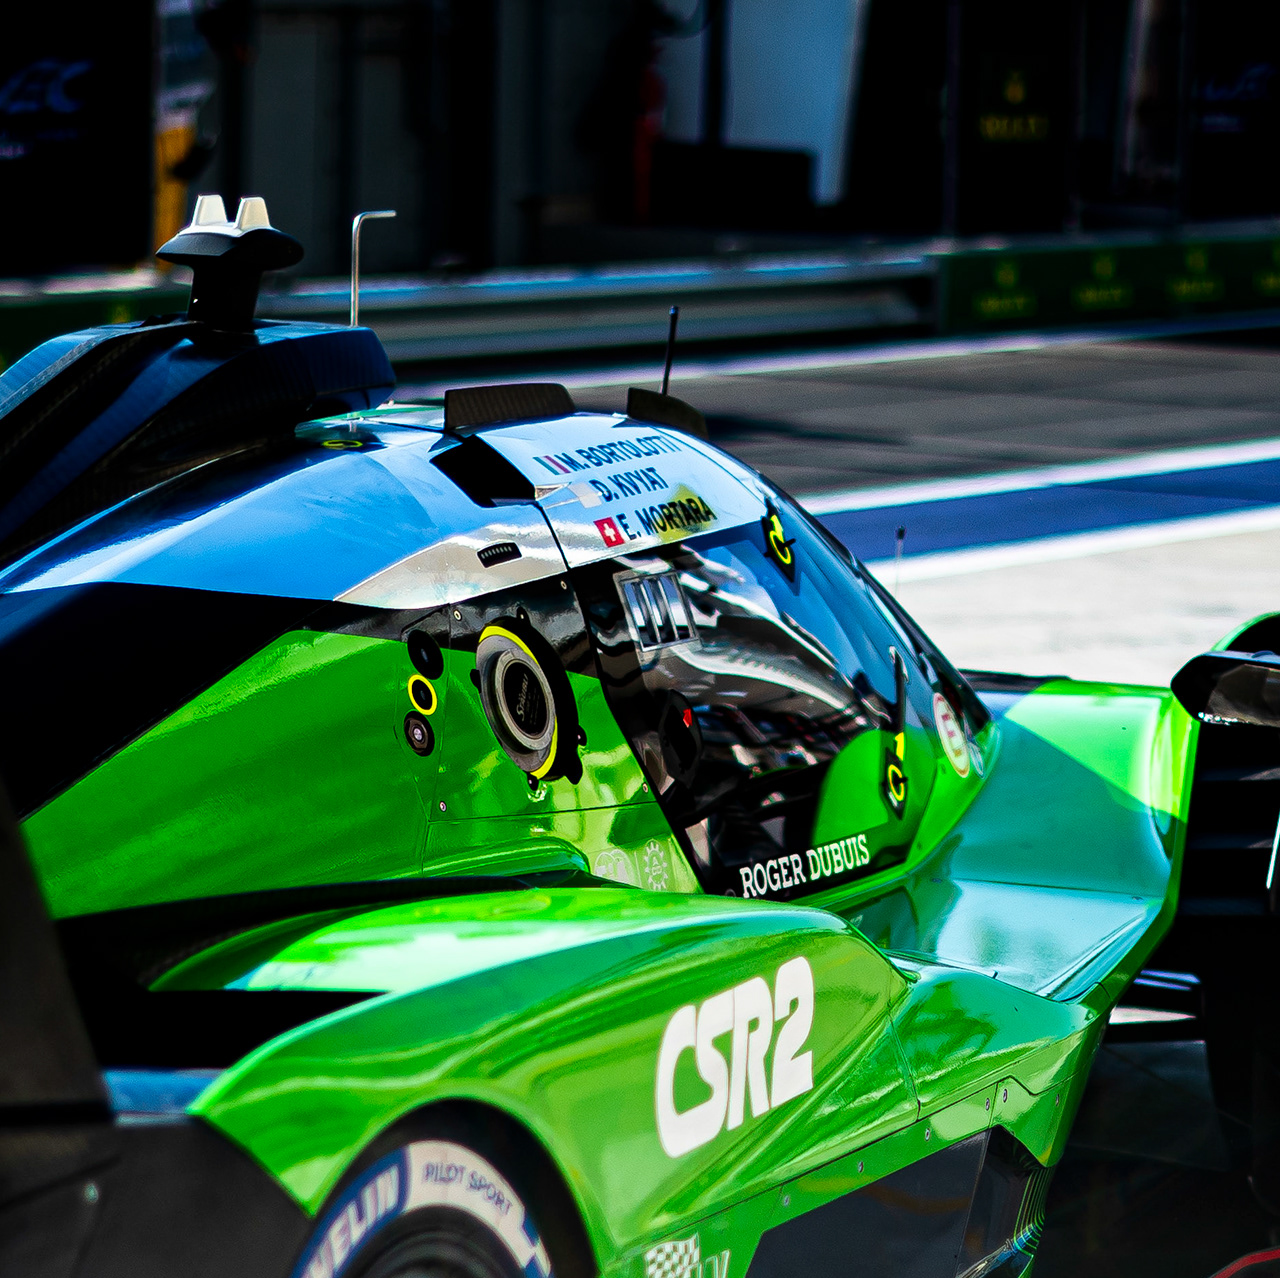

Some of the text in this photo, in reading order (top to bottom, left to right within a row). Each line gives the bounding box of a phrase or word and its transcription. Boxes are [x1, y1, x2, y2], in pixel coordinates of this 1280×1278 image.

[576, 436, 682, 468] BORTOLOTTI
[589, 467, 669, 502] D. KVYAT
[616, 497, 717, 541] E. MORTARA
[740, 834, 870, 899] ROGER DUBUIS
[656, 955, 815, 1159] CSR2
[424, 1162, 467, 1184] PILOT
[466, 1170, 513, 1216] SPORT
